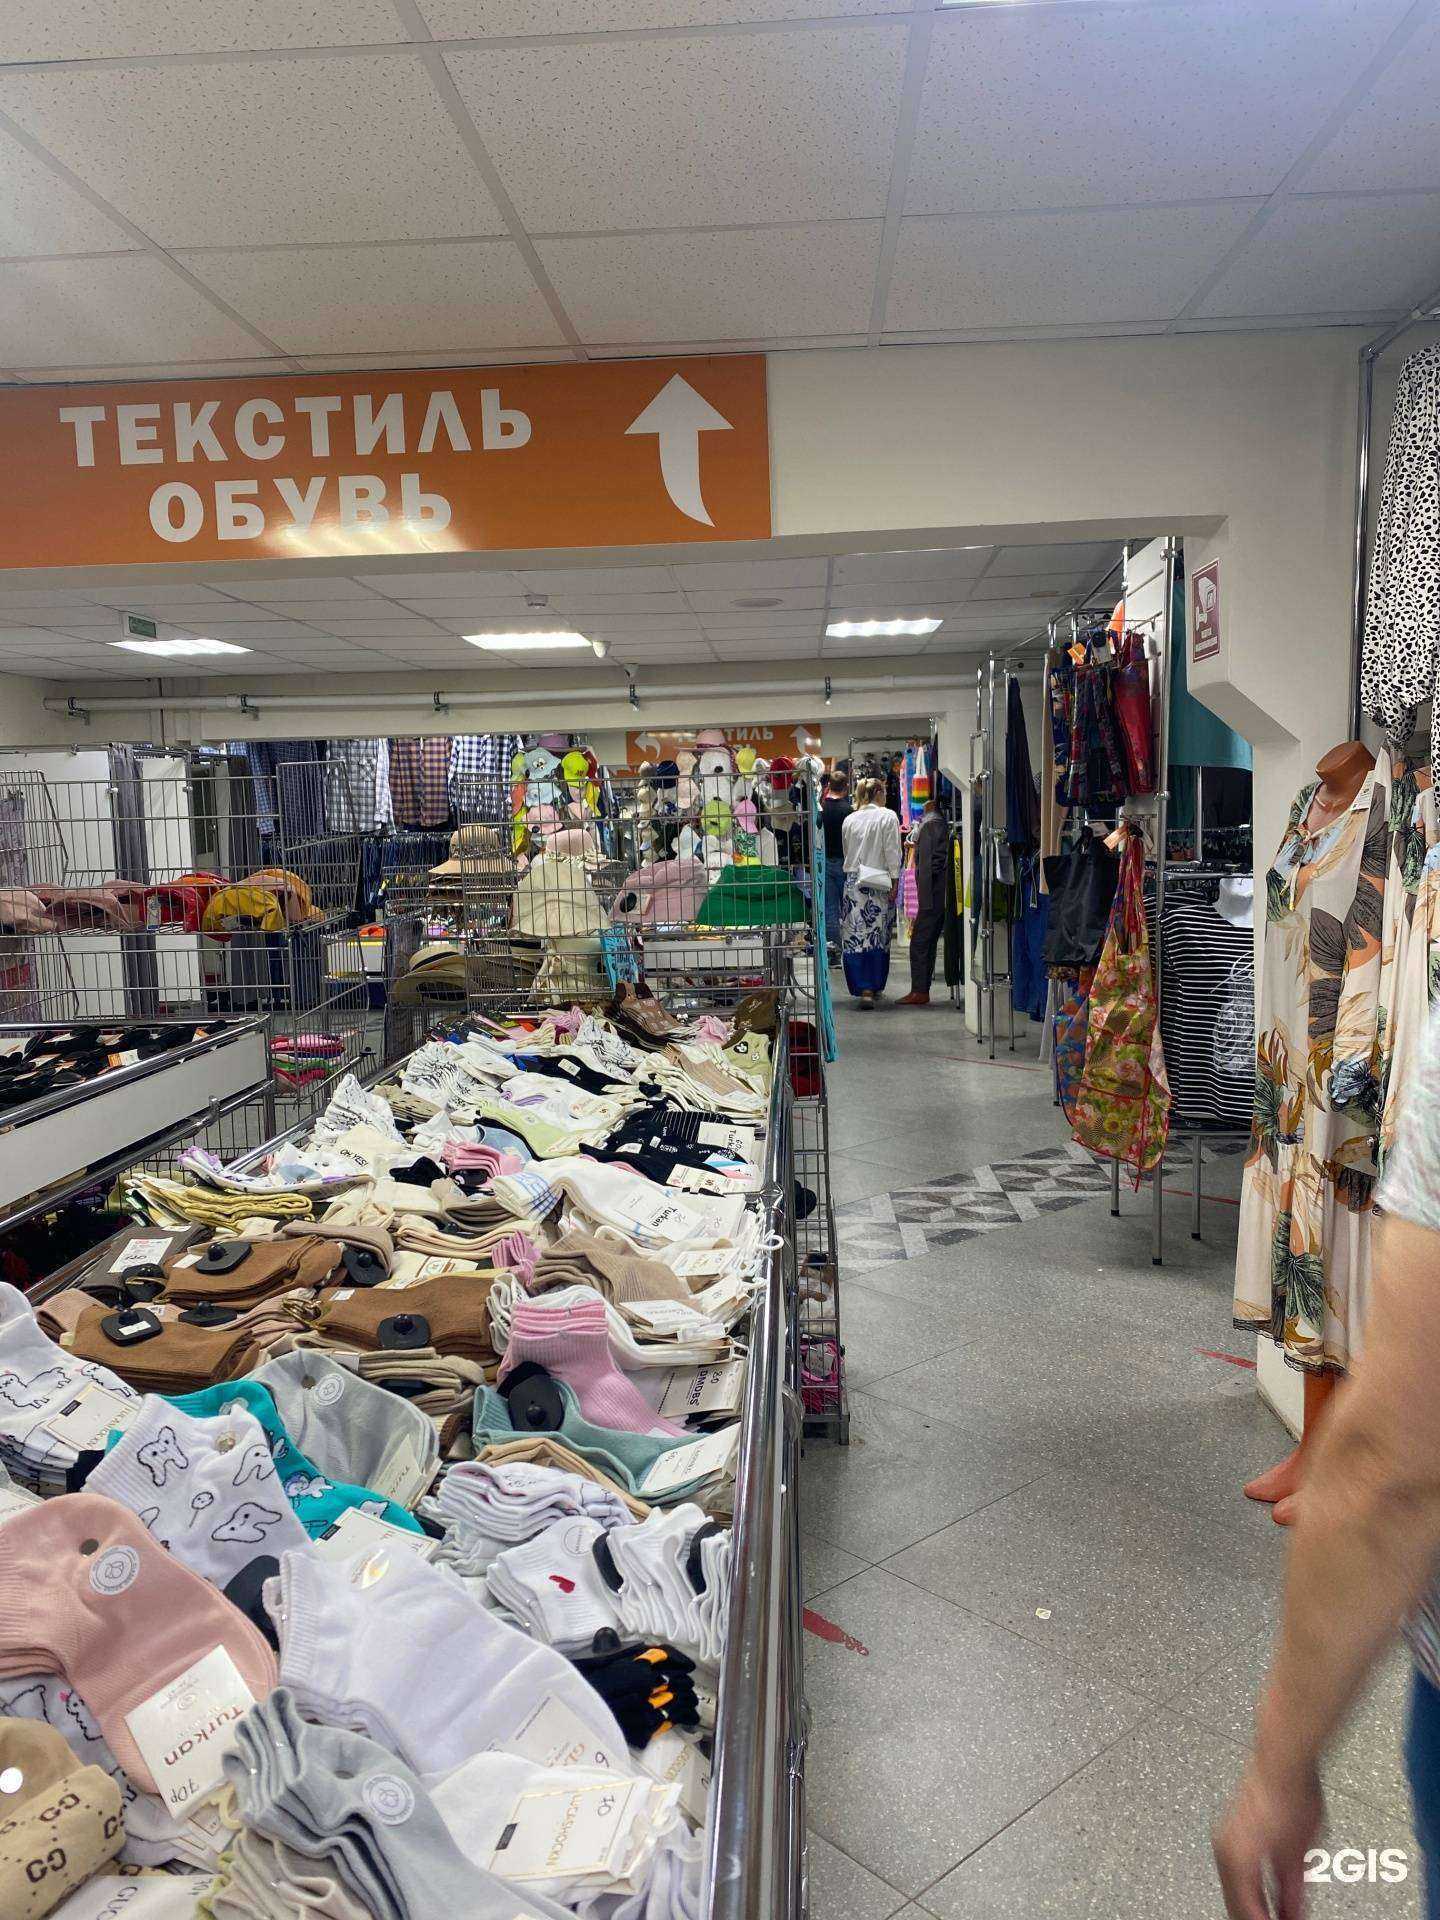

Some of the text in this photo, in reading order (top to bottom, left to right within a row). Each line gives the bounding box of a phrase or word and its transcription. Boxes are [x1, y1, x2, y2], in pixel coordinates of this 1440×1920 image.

[59, 389, 532, 467] ТЕКСТИЛЬ
[149, 473, 452, 542] ОБУВЬ
[651, 1206, 678, 1228] Turkan
[164, 1703, 244, 1768] Turkan
